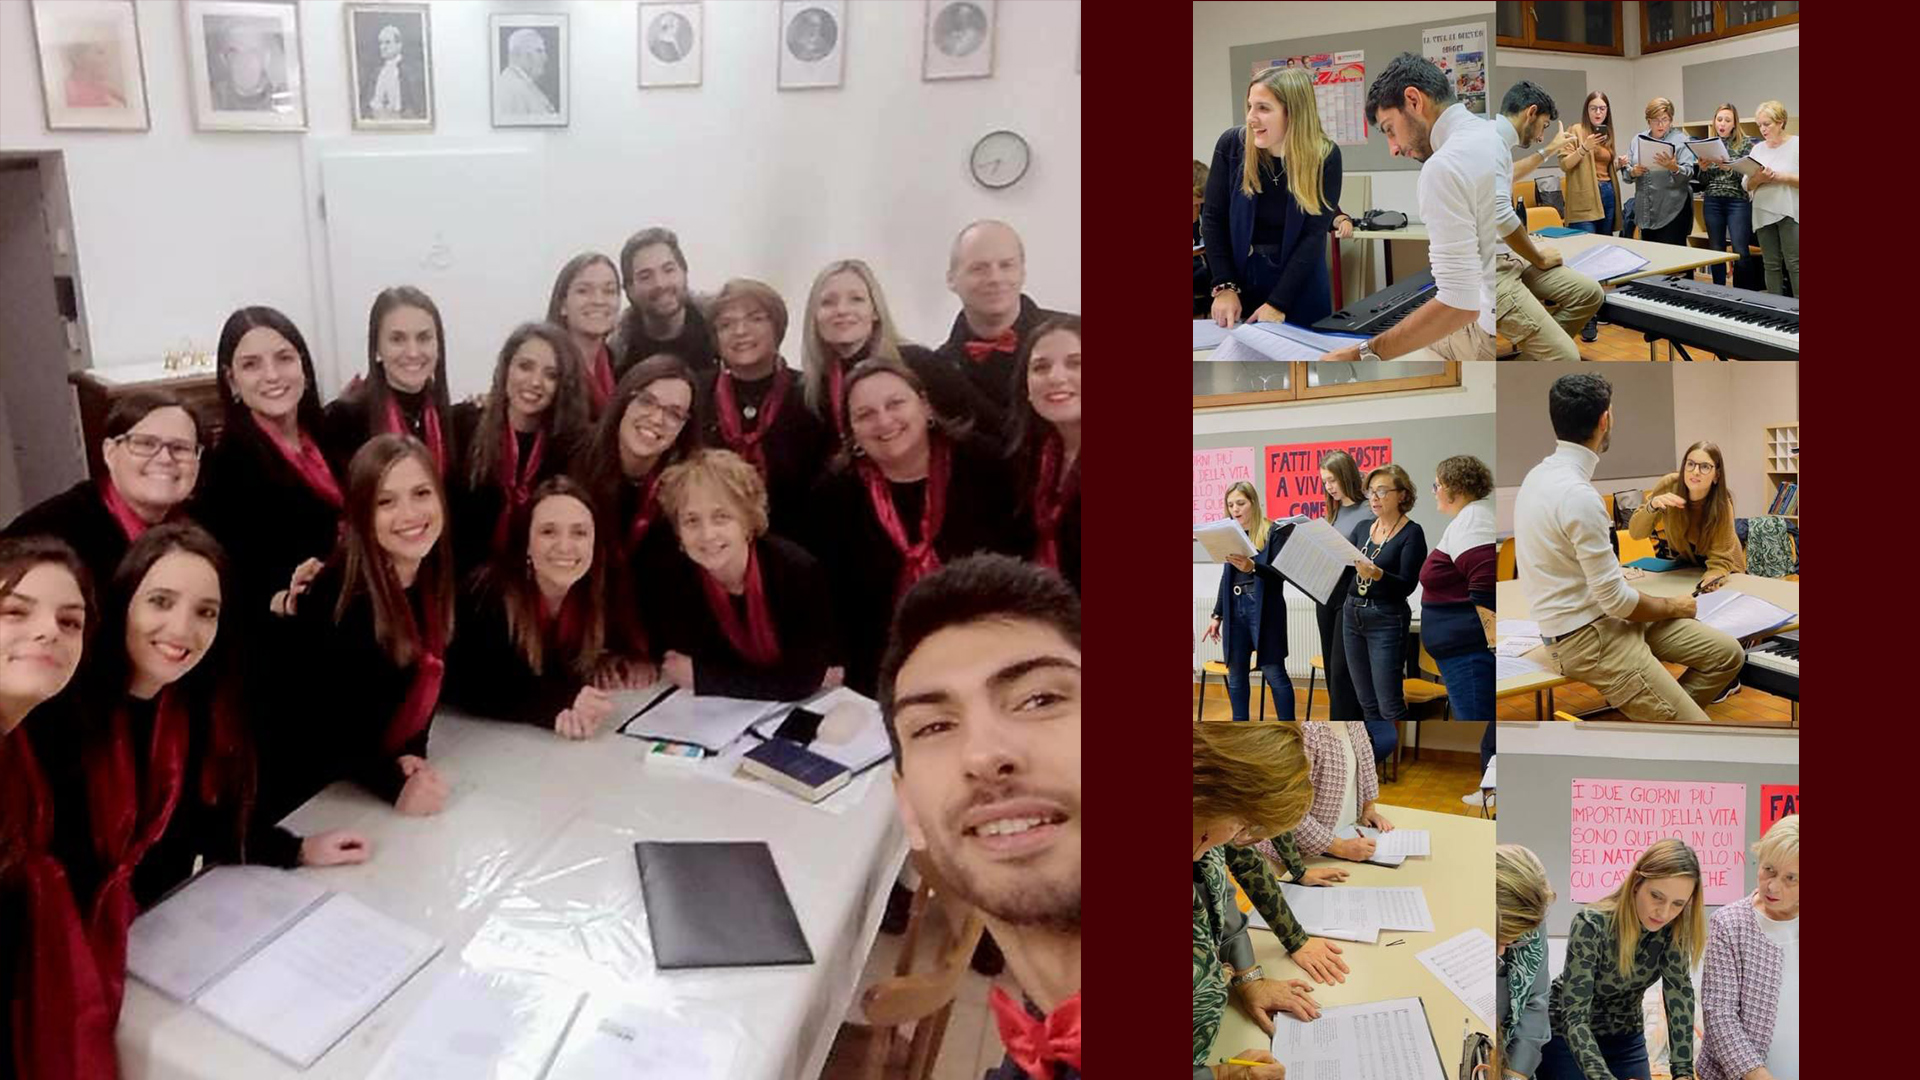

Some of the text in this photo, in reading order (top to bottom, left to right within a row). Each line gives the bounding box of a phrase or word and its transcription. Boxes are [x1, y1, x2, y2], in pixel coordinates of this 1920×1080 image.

[1271, 450, 1311, 473] FATTI
[1198, 466, 1250, 483] DELLA VITA
[1276, 476, 1289, 498] A
[1289, 501, 1326, 519] COME
[1573, 784, 1716, 805] I DUE GIORNI PIÙ
[1572, 806, 1739, 827] IMPORTANTI DELLA VITA
[1572, 827, 1618, 845] SONO
[1692, 831, 1705, 847] IN
[1712, 831, 1733, 847] CUI
[1571, 848, 1596, 865] SEI
[1696, 850, 1729, 865] LLO
[1734, 850, 1746, 866] IN
[1570, 870, 1595, 888] CUI
